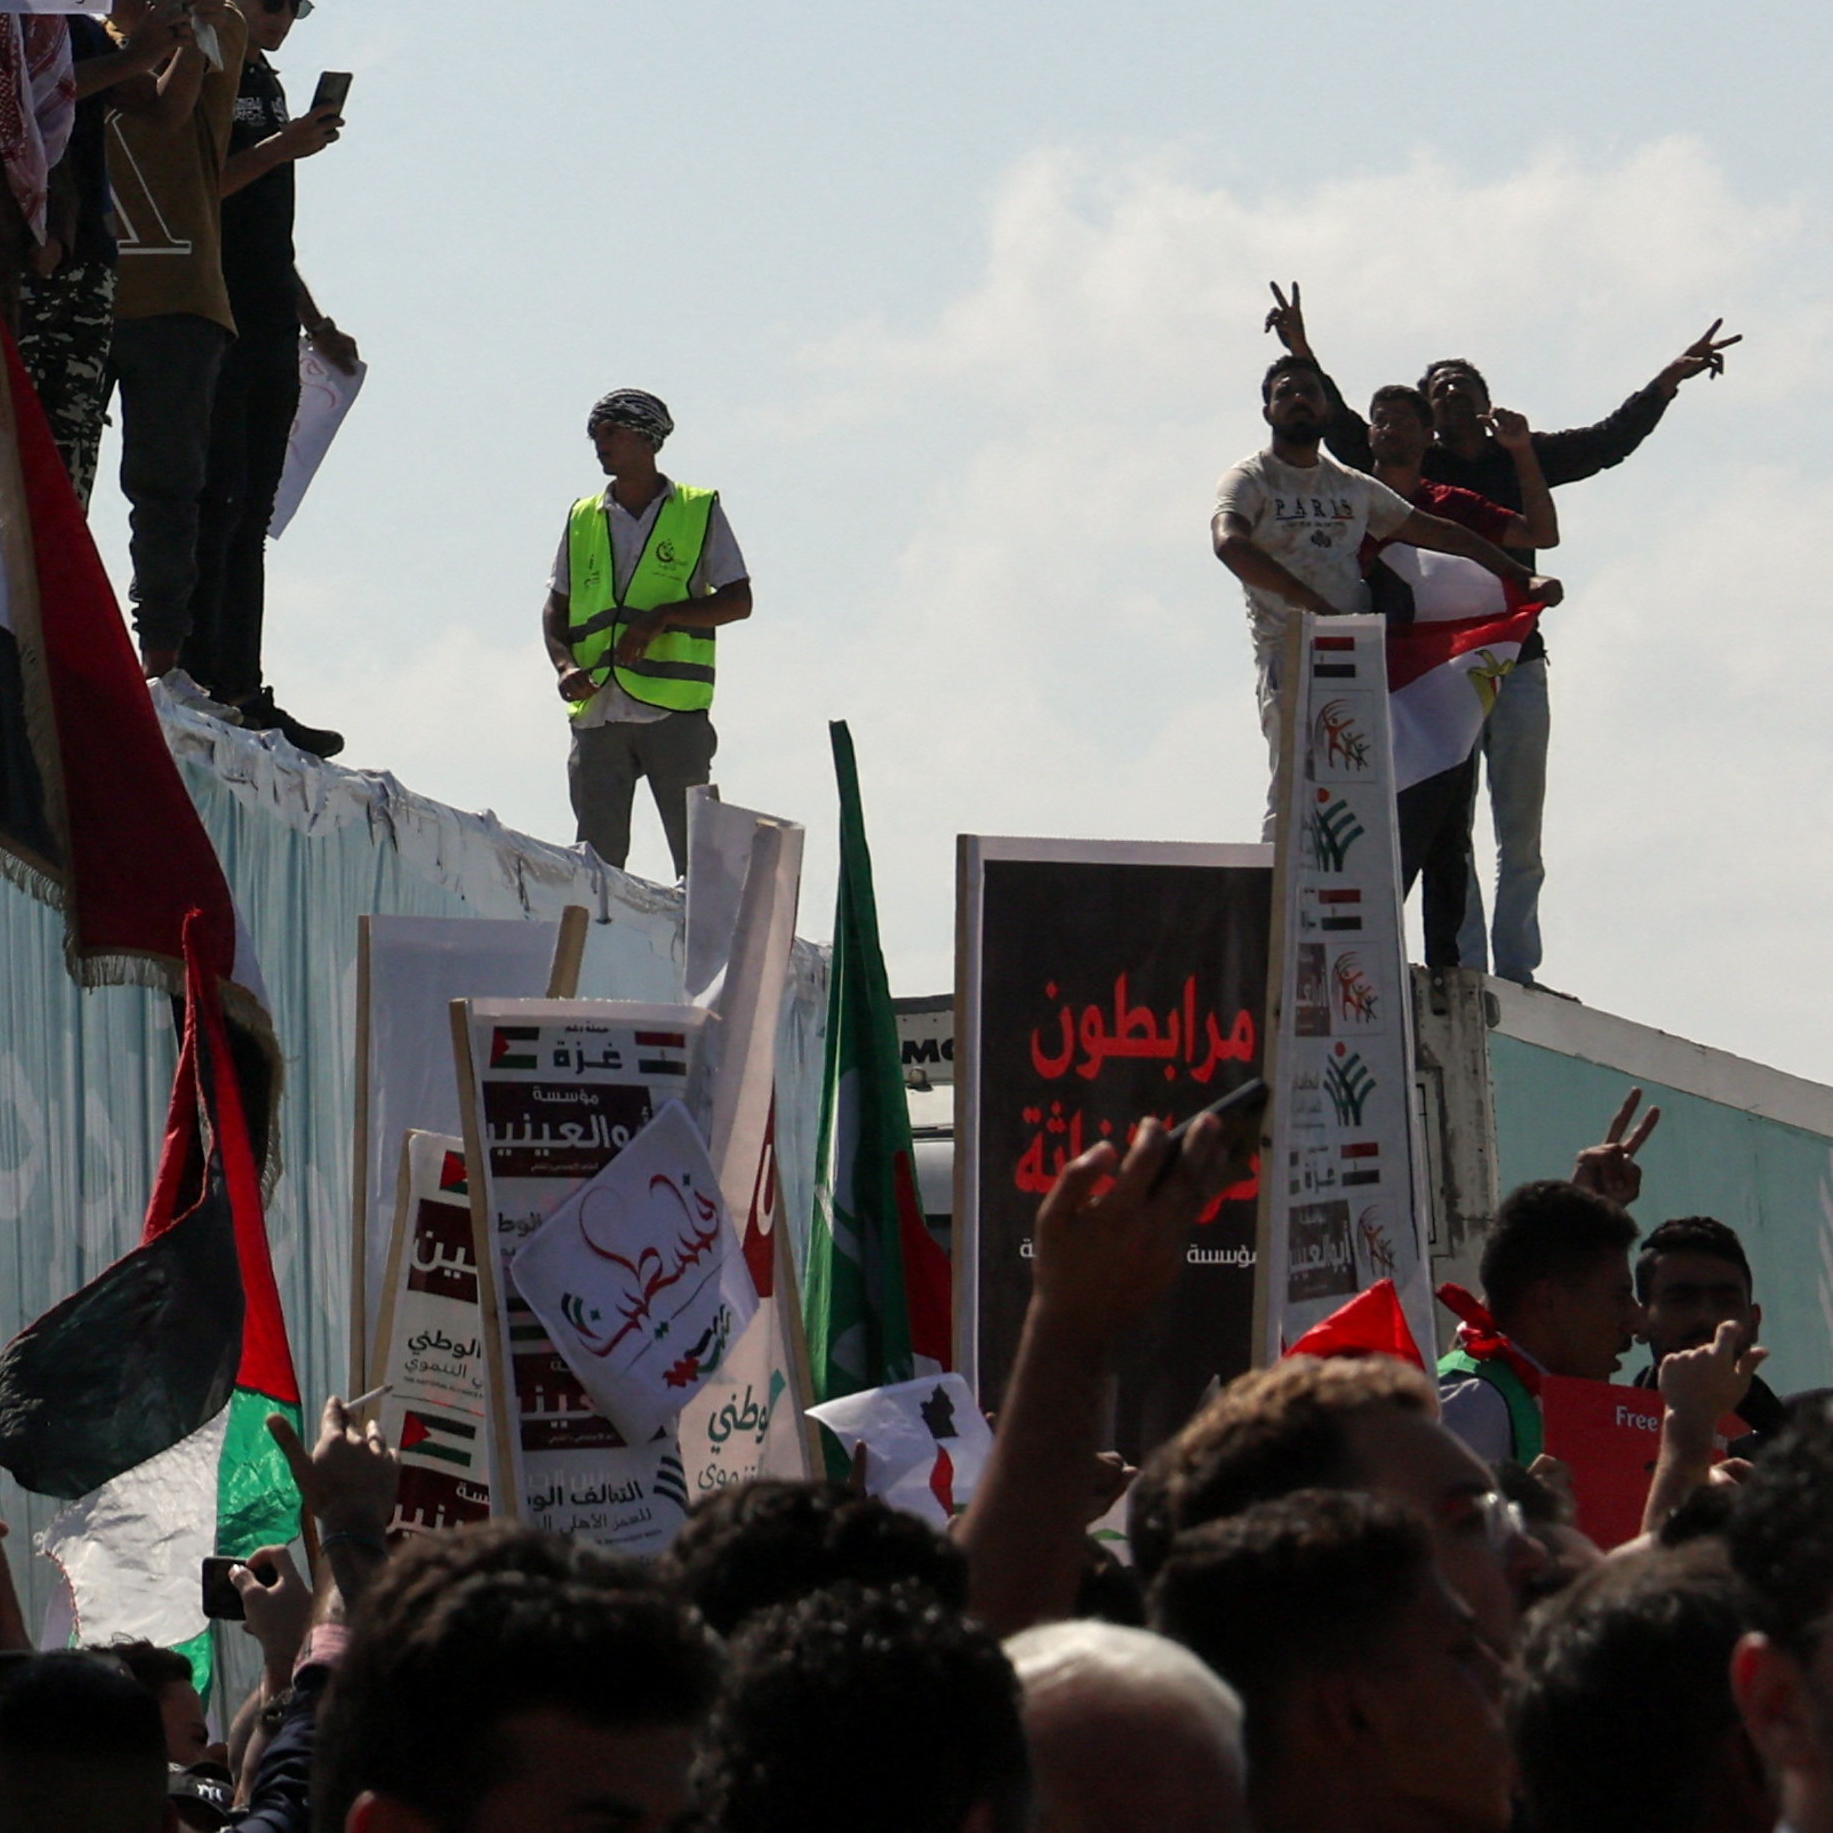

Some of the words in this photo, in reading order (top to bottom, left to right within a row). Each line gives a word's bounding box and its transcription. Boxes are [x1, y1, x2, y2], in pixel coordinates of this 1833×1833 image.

[1275, 498, 1352, 517] PARIS
[1031, 972, 1255, 1082] مرابطون
[554, 1040, 622, 1075] غزة
[532, 1086, 599, 1105] مؤسسة
[562, 1174, 721, 1357] فلسطين
[408, 1330, 481, 1359] الوطني
[1615, 1405, 1659, 1432] Free
